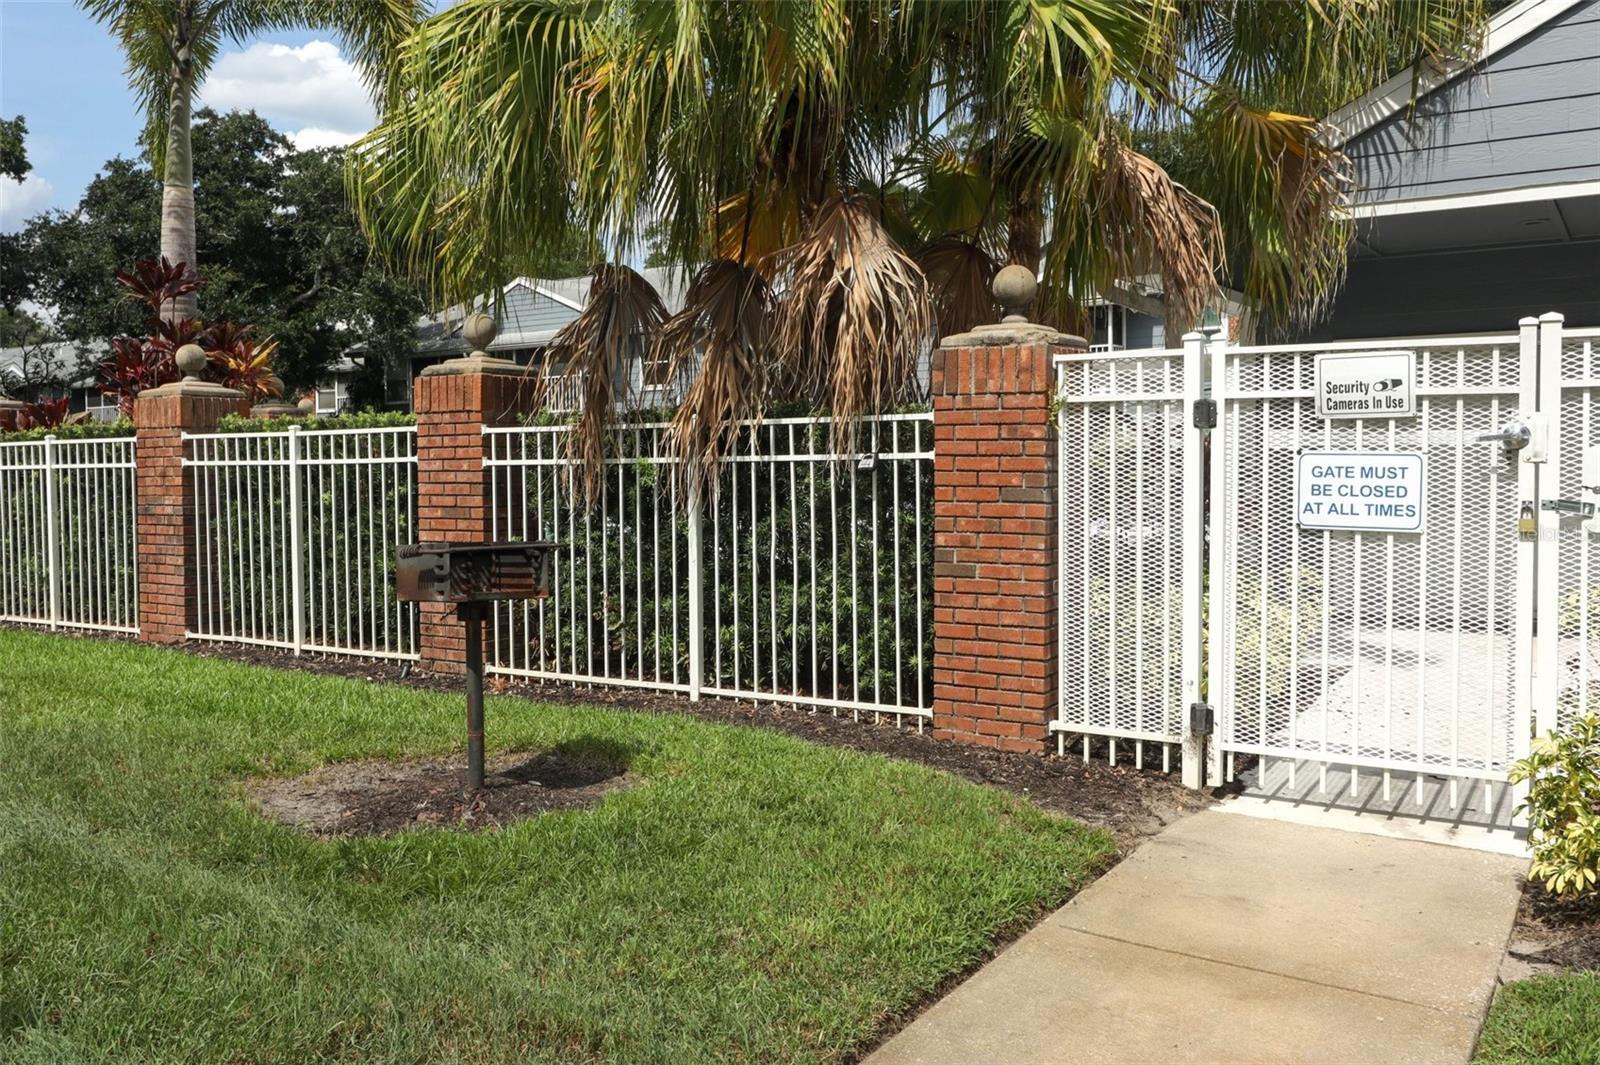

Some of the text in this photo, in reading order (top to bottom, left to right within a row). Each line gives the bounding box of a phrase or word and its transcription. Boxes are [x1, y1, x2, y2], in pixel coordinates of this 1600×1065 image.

[1326, 380, 1369, 395] Security
[1326, 395, 1404, 410] Cameras In Use
[1311, 465, 1408, 479] GATE MUST
[1311, 484, 1408, 498] BE CLOSED
[1303, 502, 1416, 517] AT ALL TIMES
